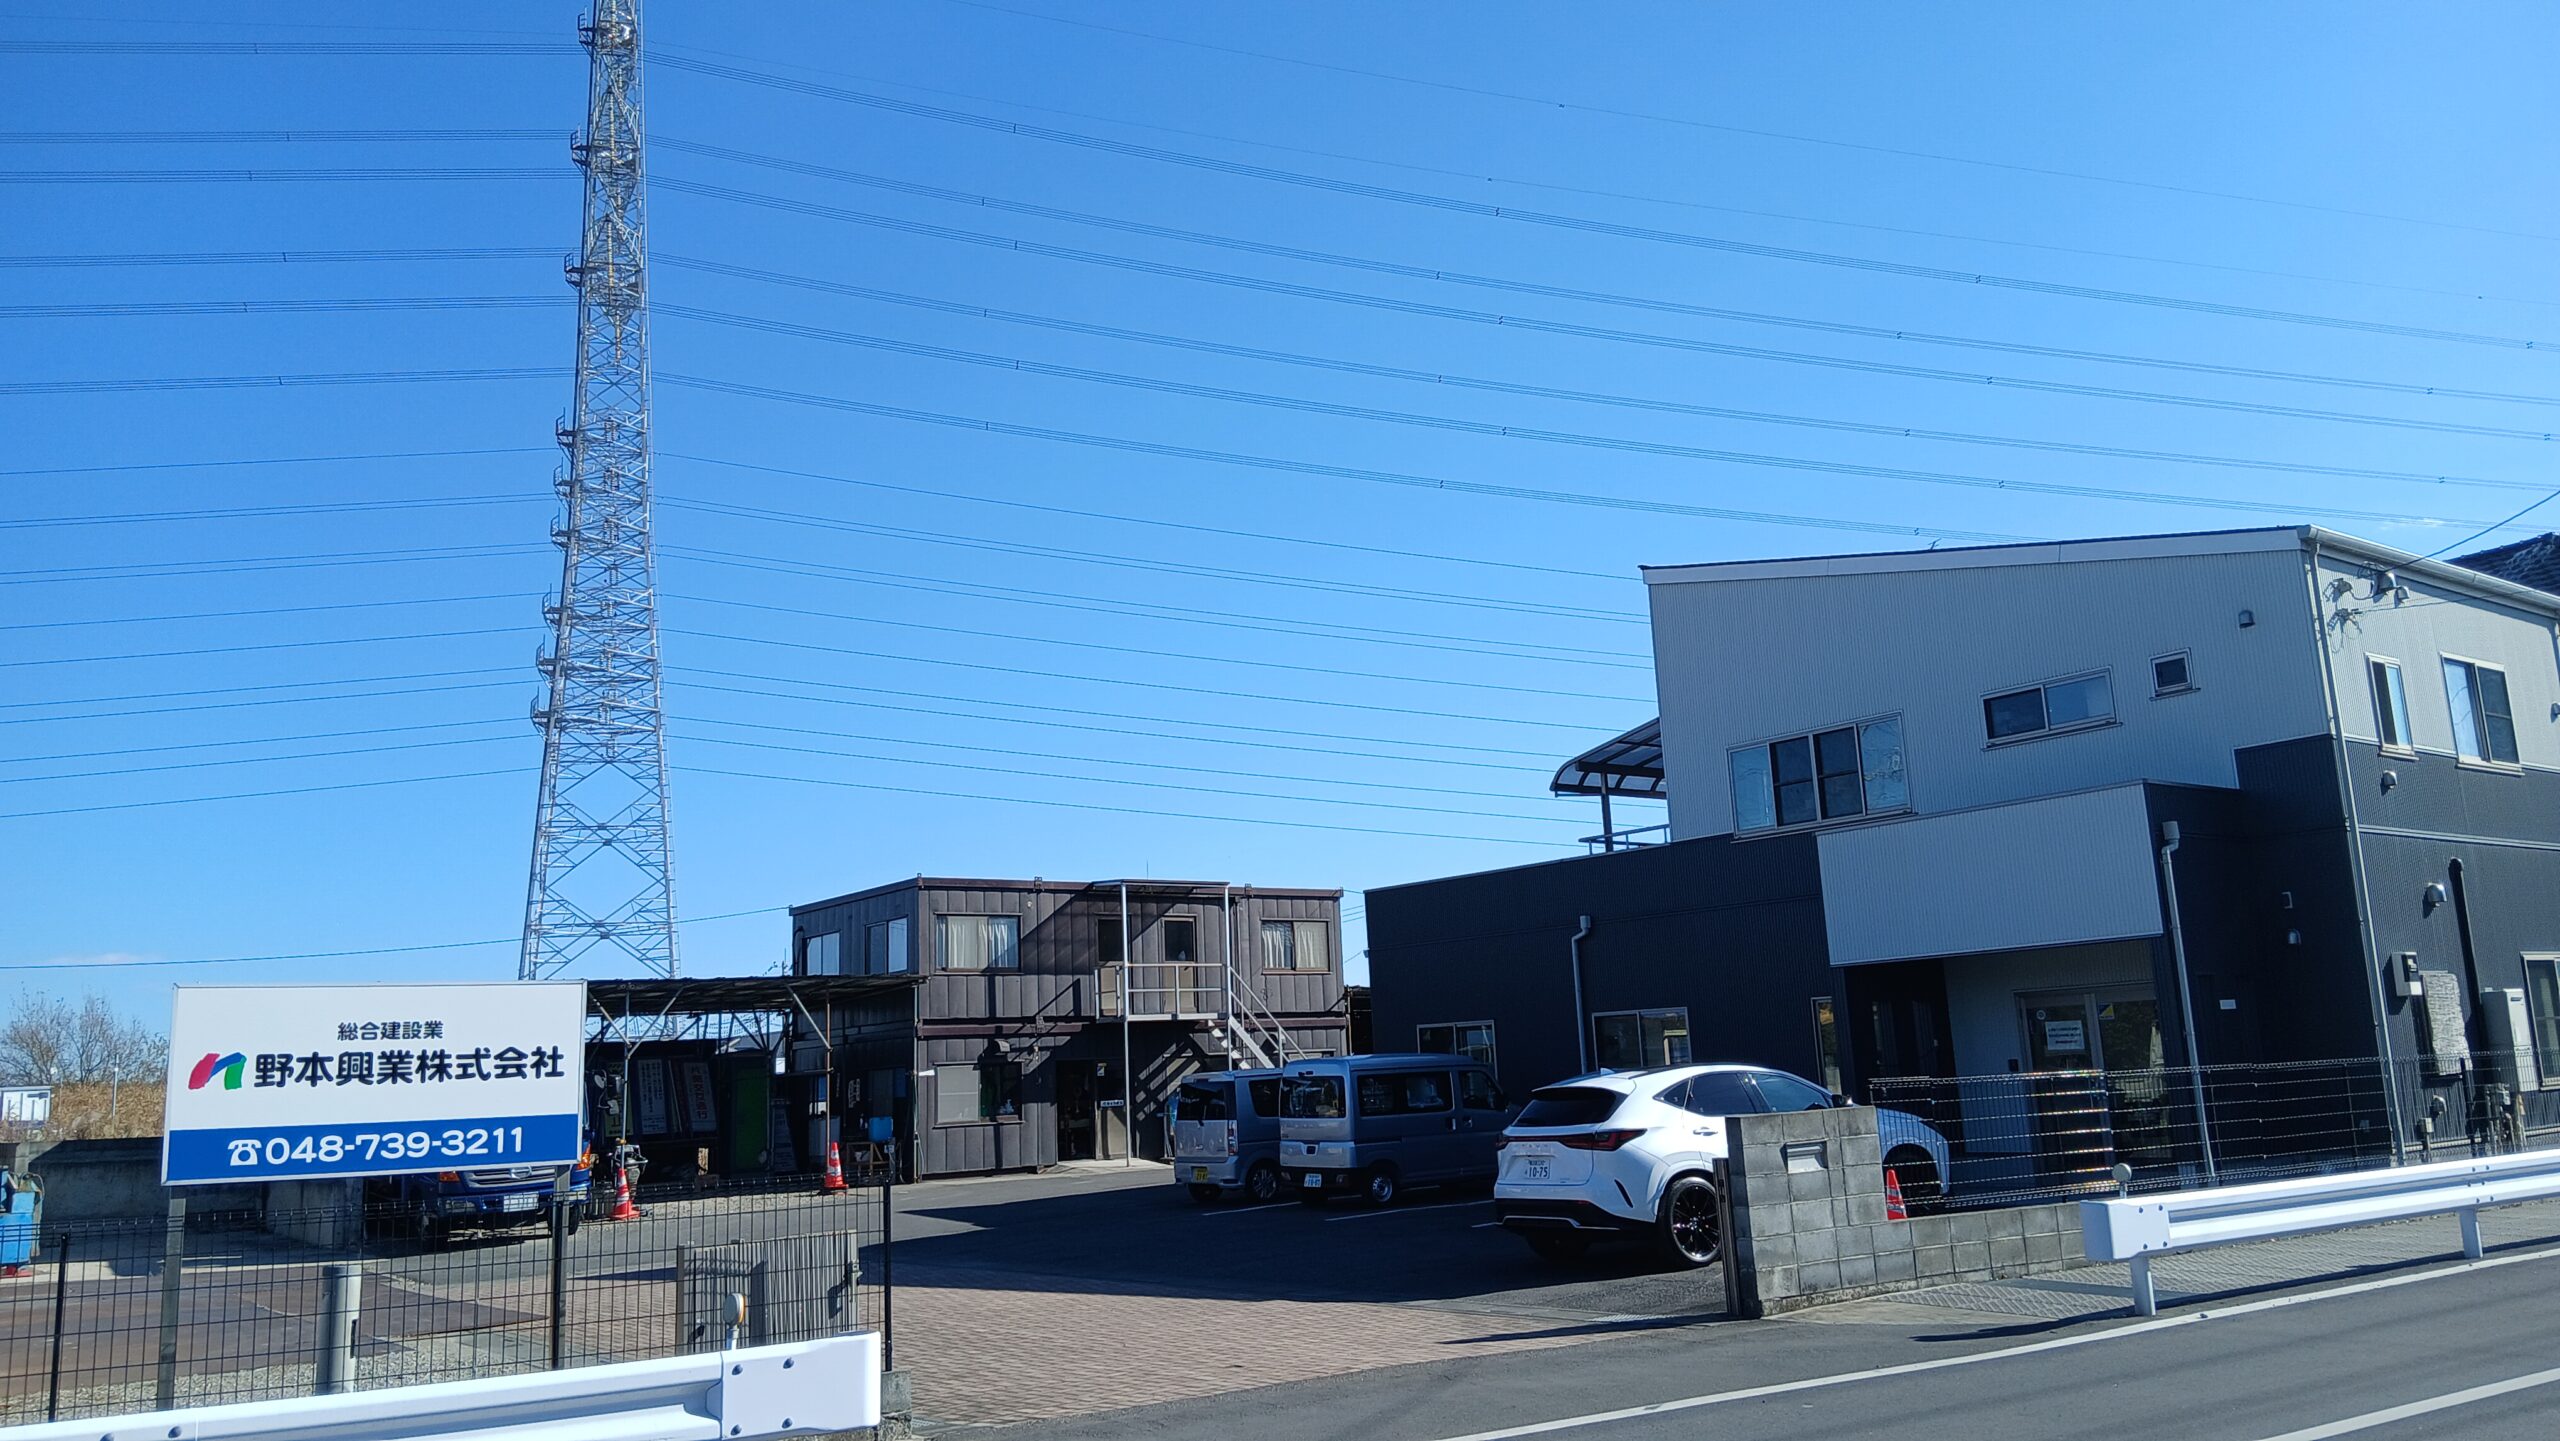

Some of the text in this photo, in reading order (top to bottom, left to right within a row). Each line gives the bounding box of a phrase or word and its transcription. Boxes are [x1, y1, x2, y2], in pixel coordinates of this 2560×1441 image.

[337, 1020, 444, 1041] 総合建設業
[253, 1045, 566, 1088] 野本興業株式会社
[265, 1126, 523, 1164] 048-739-3211
